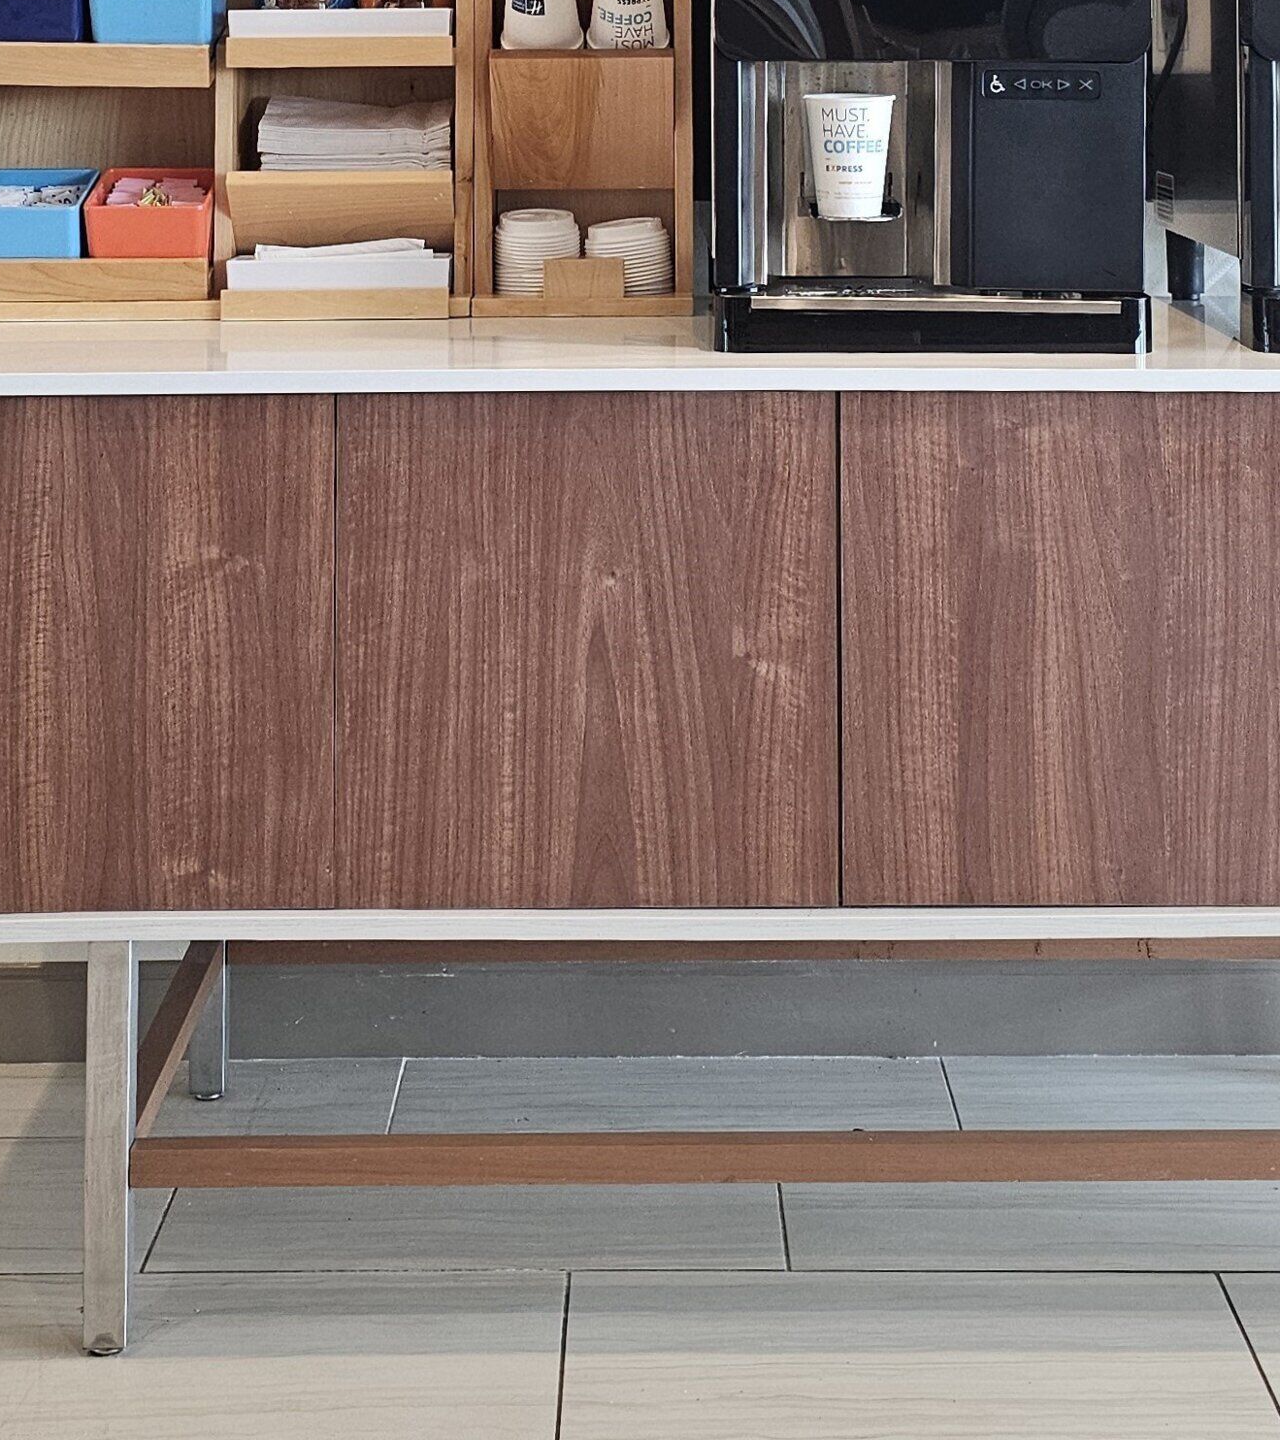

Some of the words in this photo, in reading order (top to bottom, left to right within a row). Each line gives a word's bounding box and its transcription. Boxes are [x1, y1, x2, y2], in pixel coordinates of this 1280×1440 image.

[597, 6, 652, 26] COFFEE.
[611, 22, 654, 39] HAVE.
[1030, 80, 1053, 89] OK
[821, 108, 870, 122] MUST.
[822, 124, 869, 138] HAVE.
[825, 164, 863, 173] EXPRESS
